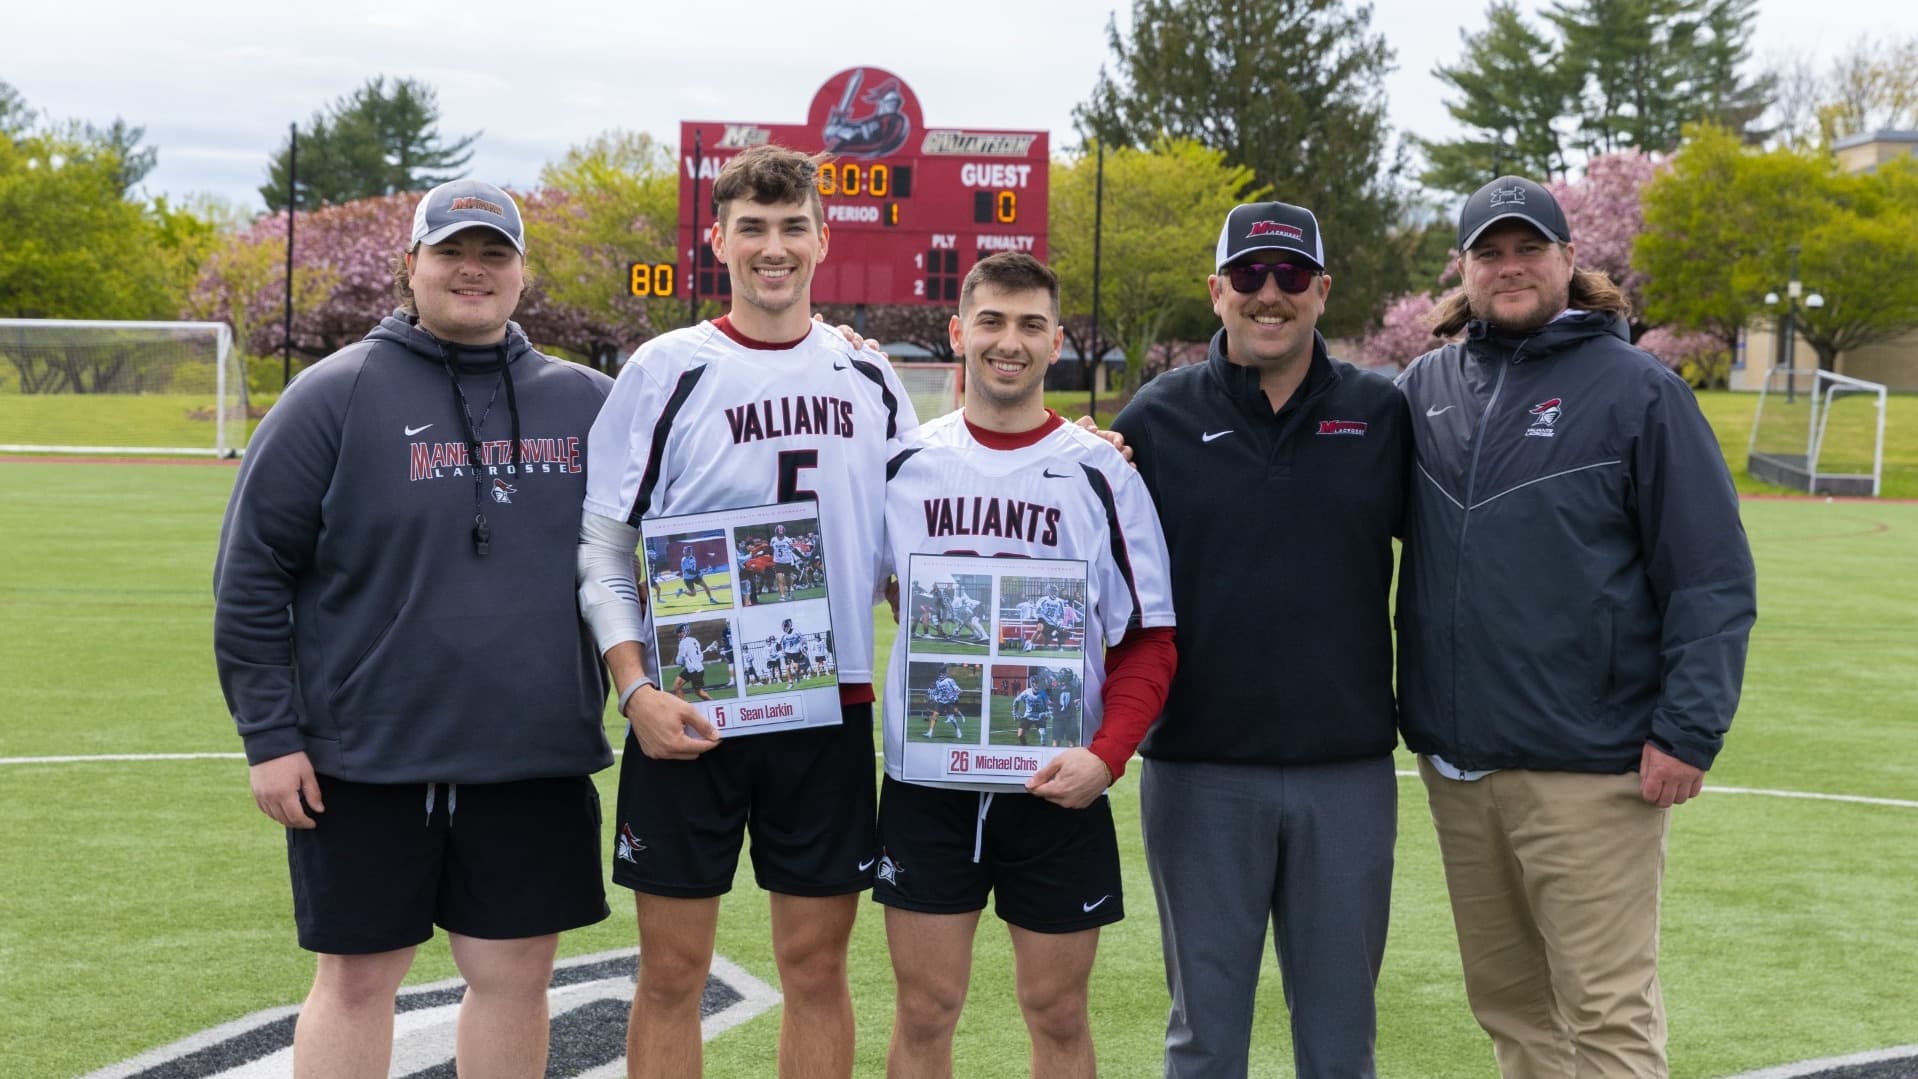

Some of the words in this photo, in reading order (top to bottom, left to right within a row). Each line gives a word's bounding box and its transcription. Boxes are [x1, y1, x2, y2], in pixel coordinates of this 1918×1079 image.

[961, 162, 1032, 188] GUEST
[828, 205, 879, 222] PERIOD
[998, 190, 1016, 223] 0
[931, 234, 956, 249] PLY
[977, 234, 1035, 251] PENALTY
[914, 253, 923, 269] 1
[632, 263, 673, 296] 80
[914, 279, 924, 296] 2
[724, 395, 854, 444] VALIANTS
[435, 464, 567, 478] LAROSSE
[923, 496, 1061, 547] VALIANTS
[715, 706, 726, 727] 5
[740, 707, 764, 721] Sean
[765, 703, 793, 718] Larkin
[951, 751, 969, 772] 26
[975, 755, 1012, 770] Michael
[1014, 757, 1038, 771] Chris
